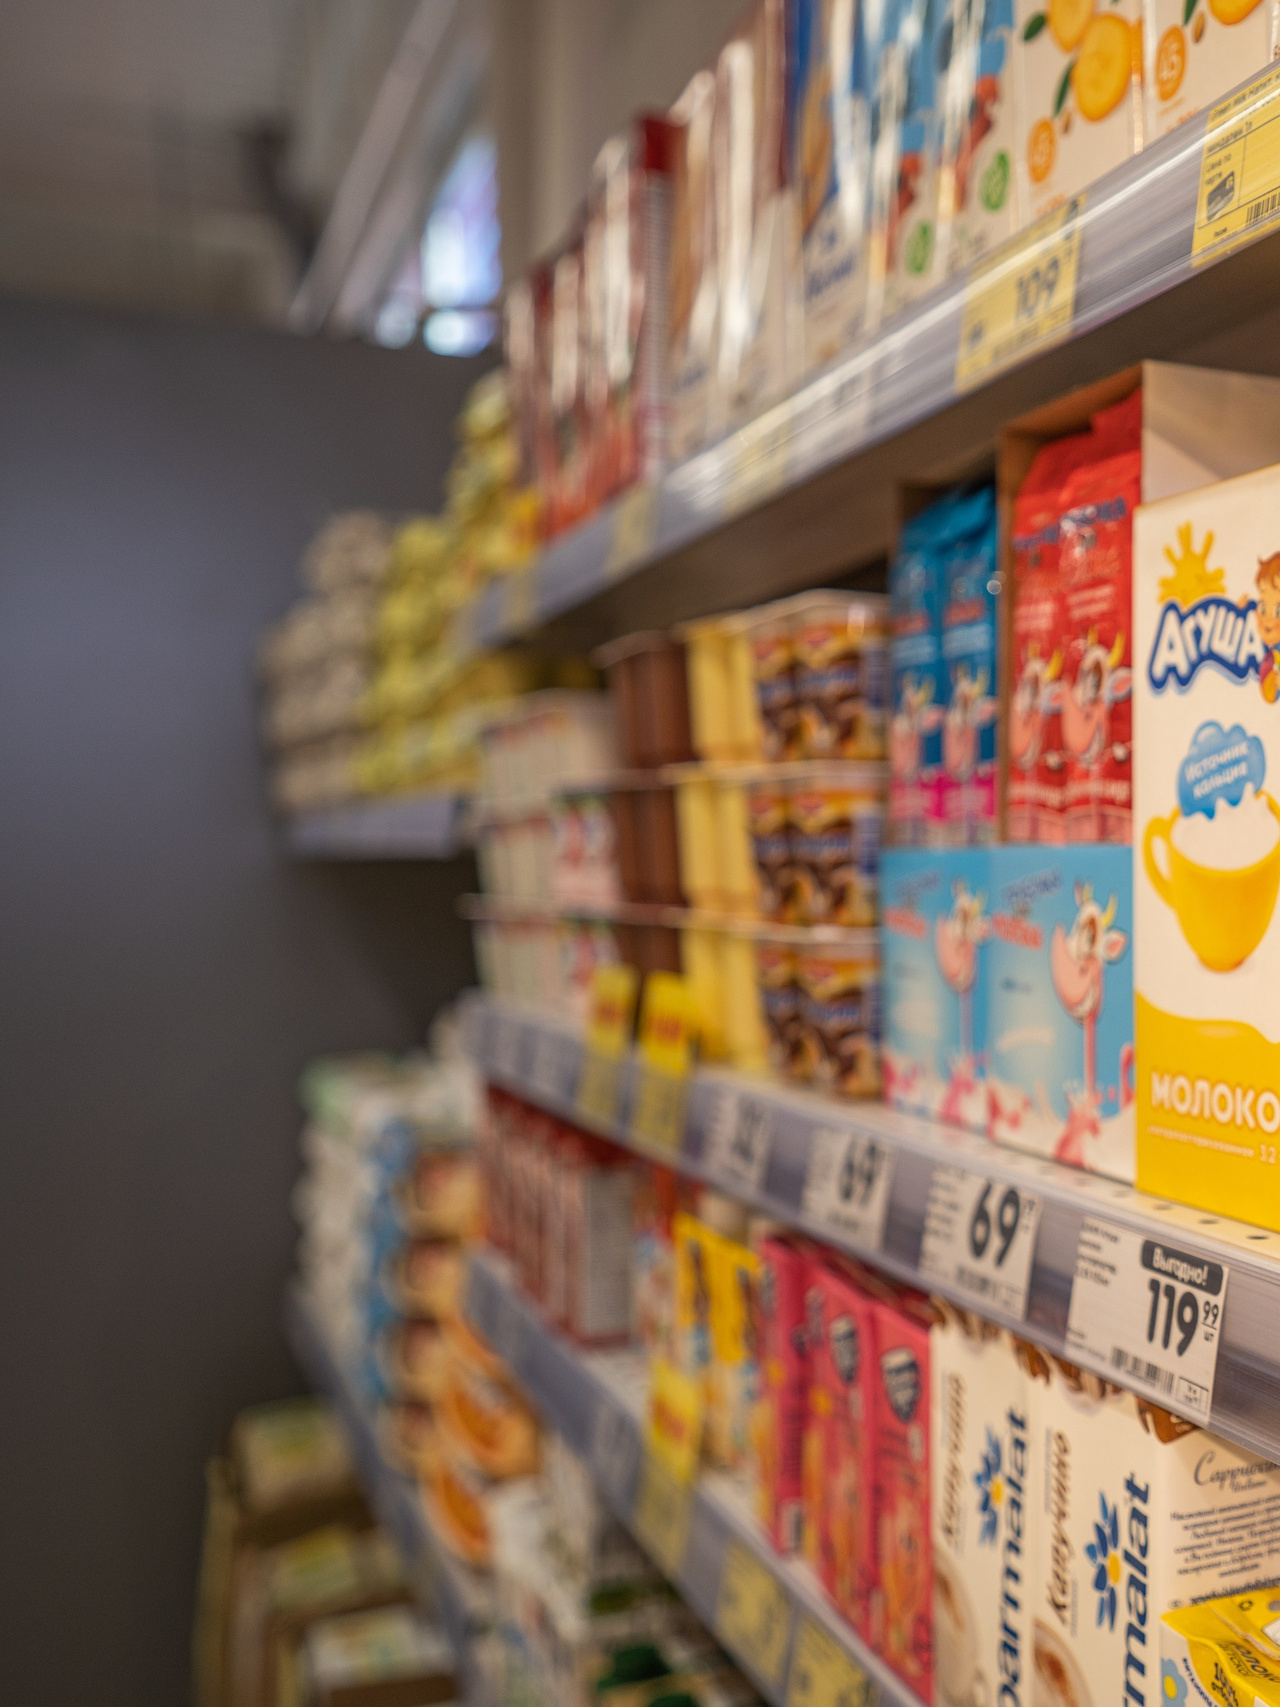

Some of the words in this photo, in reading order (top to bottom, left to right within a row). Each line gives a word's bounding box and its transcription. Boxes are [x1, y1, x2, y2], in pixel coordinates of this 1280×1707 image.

[969, 1177, 1022, 1269] 69
[1152, 1246, 1209, 1288] Выгодно!
[1146, 1277, 1199, 1358] 119
[1202, 1300, 1219, 1325] 99
